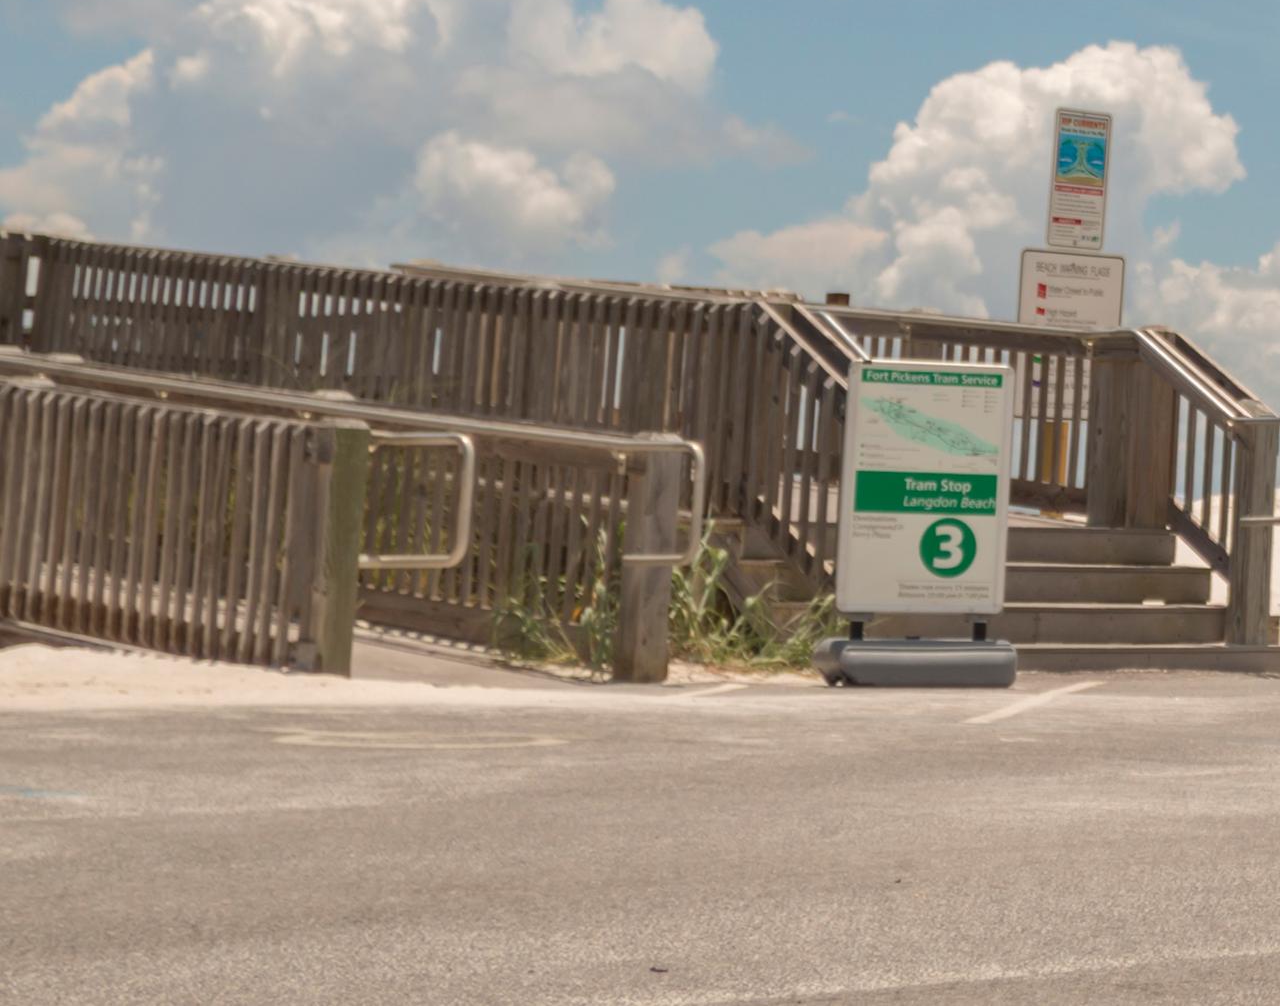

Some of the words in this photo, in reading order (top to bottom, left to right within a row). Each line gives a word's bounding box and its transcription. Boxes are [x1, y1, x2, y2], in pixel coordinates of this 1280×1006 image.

[1036, 262, 1057, 273] BEACH
[867, 369, 889, 380] Fort
[891, 371, 930, 382] Pickens
[933, 373, 959, 384] Tram
[961, 375, 998, 386] Service
[904, 477, 937, 492] Tram
[940, 478, 972, 495] Stop
[902, 495, 958, 511] Langdon
[960, 497, 996, 509] Beach
[932, 524, 964, 570] 3
